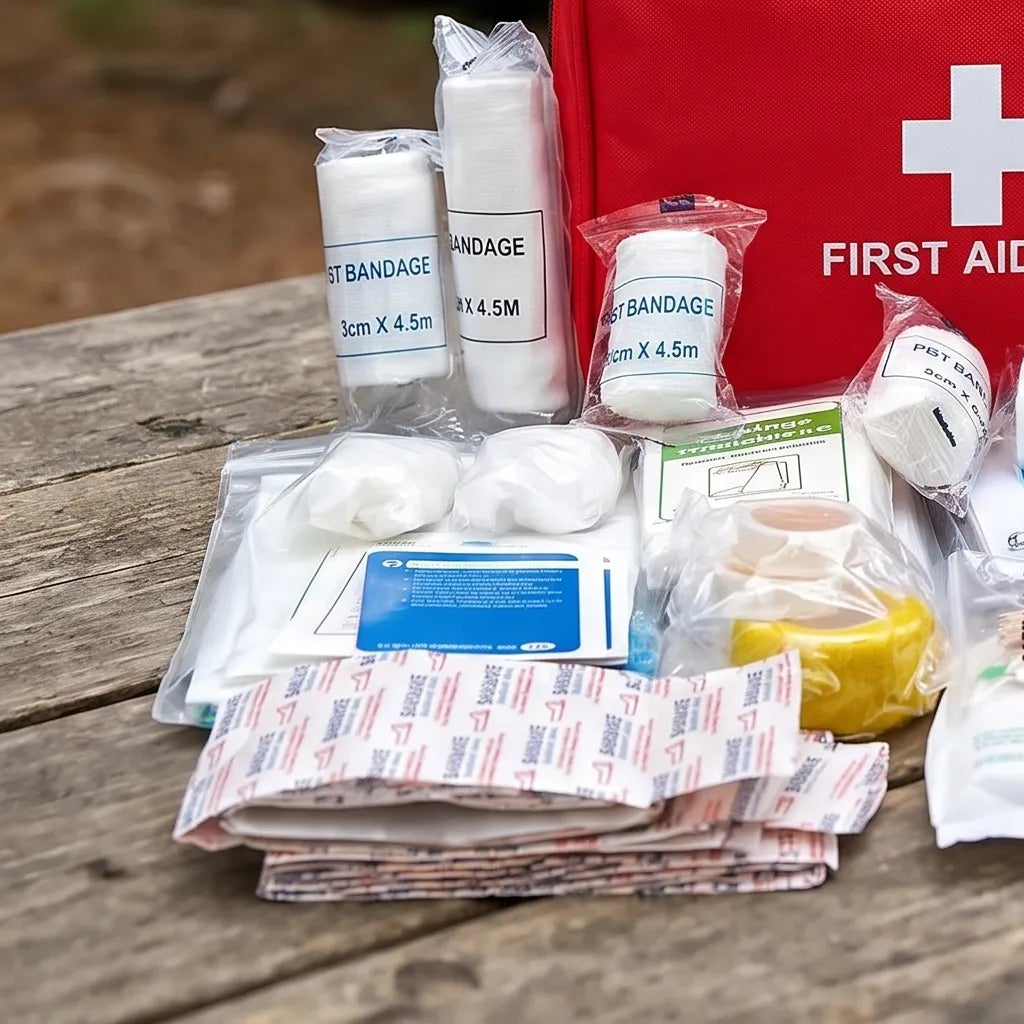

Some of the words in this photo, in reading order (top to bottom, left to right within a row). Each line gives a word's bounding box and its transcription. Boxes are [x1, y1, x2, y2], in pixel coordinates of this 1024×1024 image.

[345, 256, 431, 283] BANDAGE
[823, 241, 948, 276] FIRST
[465, 297, 474, 315] X
[477, 299, 520, 317] 4.5M
[627, 295, 714, 318] BANDAGE
[341, 319, 371, 338] 3cm
[376, 315, 389, 334] X
[394, 313, 433, 332] 4.5m
[638, 341, 650, 359] X
[656, 341, 698, 359] 4.5m
